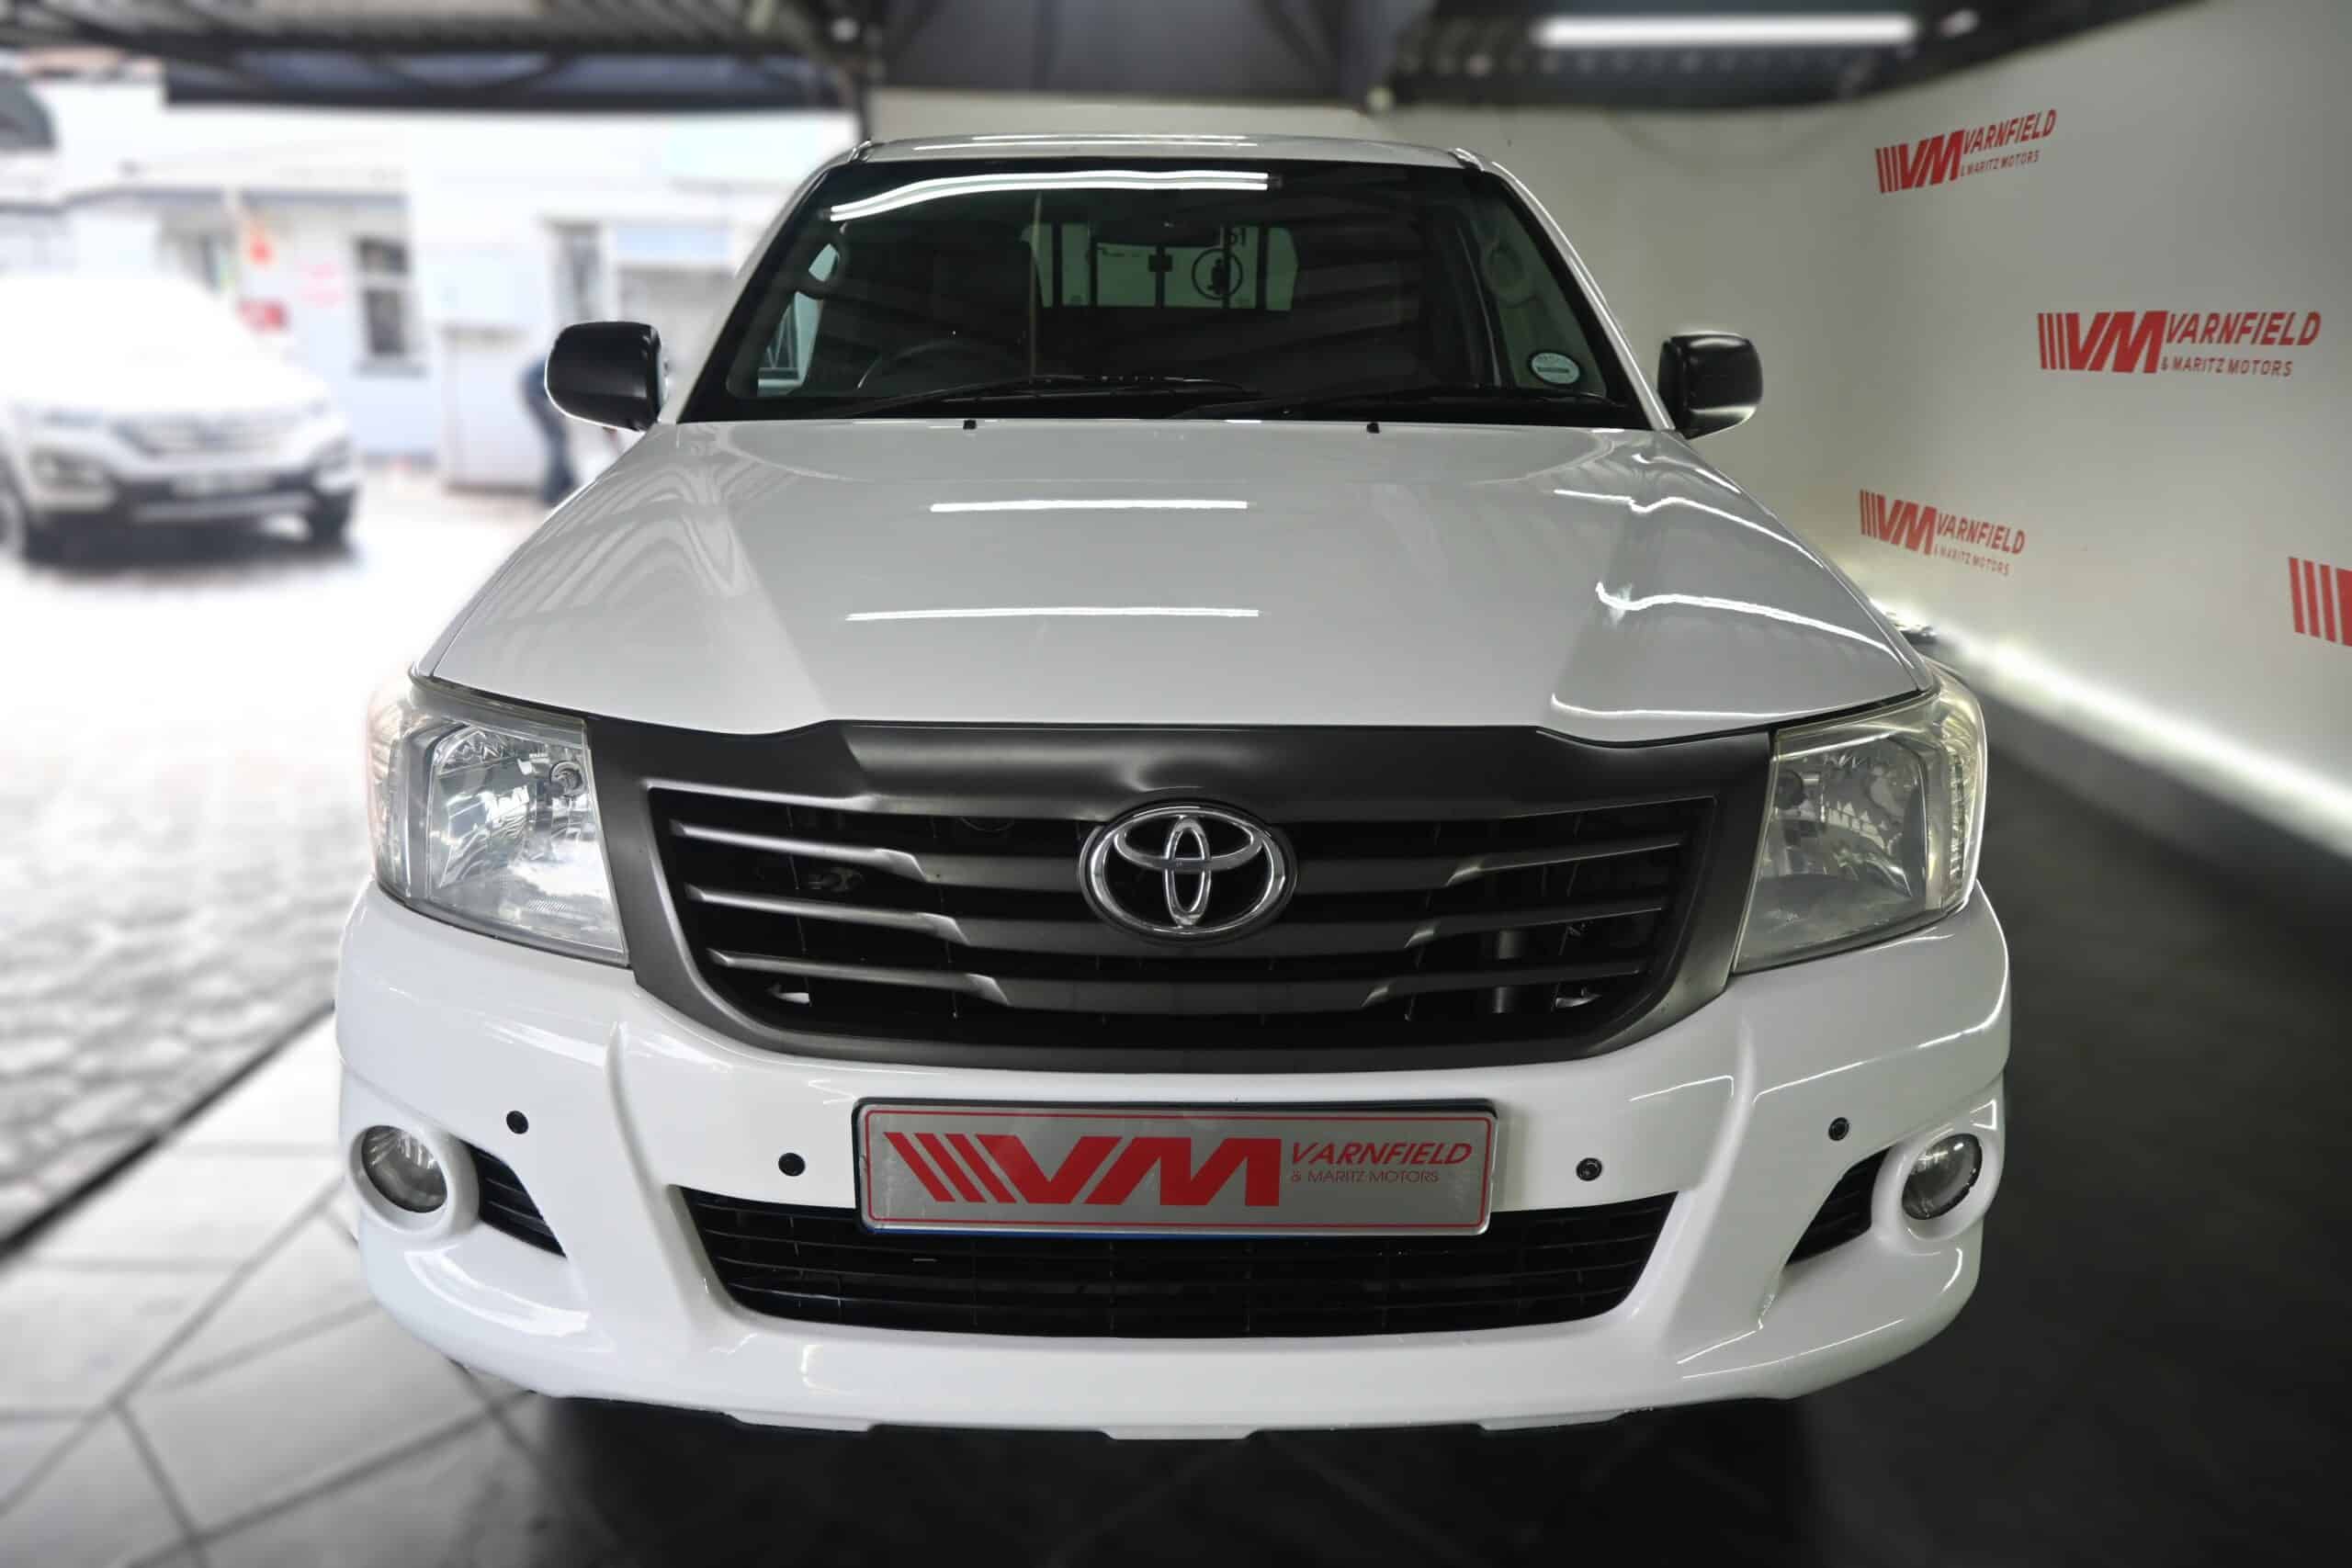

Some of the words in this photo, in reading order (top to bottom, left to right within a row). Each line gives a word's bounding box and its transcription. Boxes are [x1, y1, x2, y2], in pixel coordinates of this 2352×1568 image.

[1962, 108, 2057, 154] VARNFIELD
[1898, 130, 1965, 189] VM
[2000, 150, 2040, 169] MOTORS
[2066, 310, 2168, 373] VM
[2165, 311, 2322, 345] VARNFIELD
[2173, 356, 2223, 373] MARITZ
[2227, 359, 2293, 377] MOTORS
[1877, 493, 1937, 556] VM
[1936, 513, 2027, 555] VARNFIELD
[1973, 555, 2010, 576] MOTORS
[976, 1134, 1282, 1206] VM
[1292, 1142, 1473, 1165] VARNFIELD
[1291, 1169, 1302, 1183] &
[1368, 1169, 1440, 1184] MOTORS
